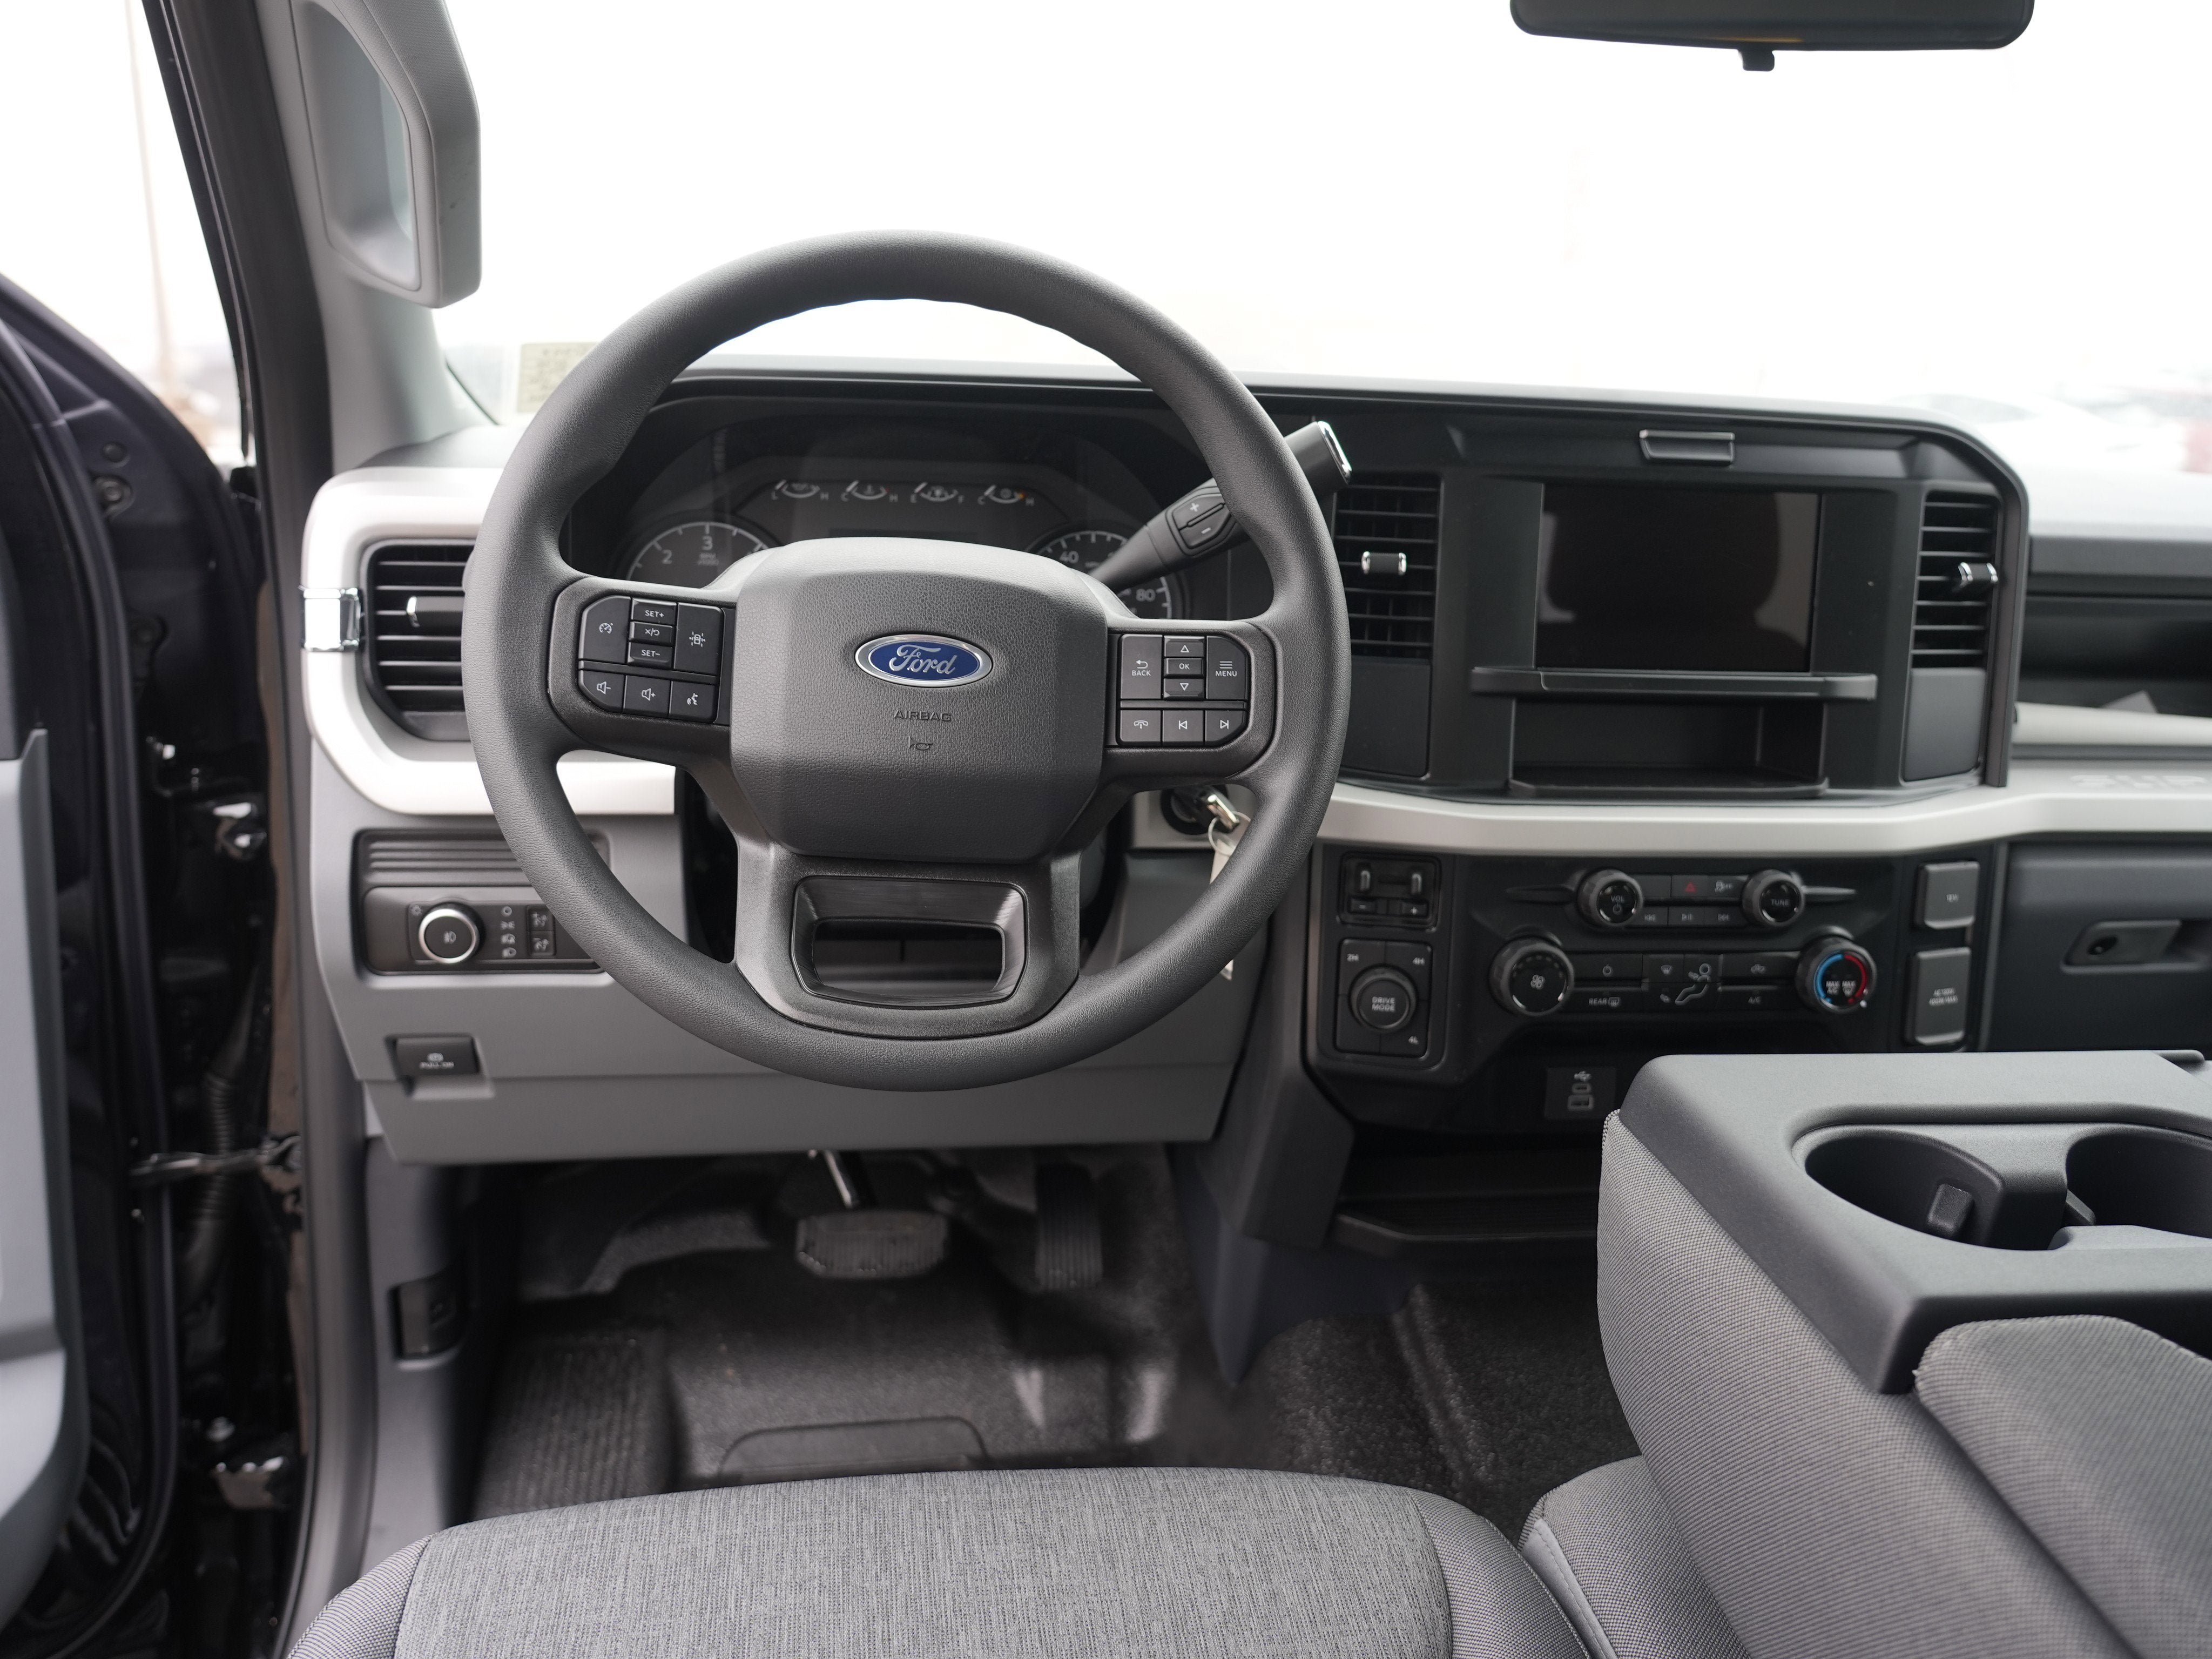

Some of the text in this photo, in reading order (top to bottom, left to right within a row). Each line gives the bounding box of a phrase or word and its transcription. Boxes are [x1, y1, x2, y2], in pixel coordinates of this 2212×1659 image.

[703, 536, 713, 550] 3
[662, 549, 672, 564] 2
[1060, 551, 1079, 564] 40
[1136, 589, 1156, 602] 80
[889, 644, 957, 675] Ford
[893, 710, 952, 722] AIRBAG
[1610, 895, 1624, 903] VOL
[1771, 899, 1790, 907] TUNE
[1347, 953, 1359, 962] 2H
[1412, 957, 1425, 966] 4H
[1372, 996, 1395, 1004] DRIVE
[1748, 996, 1762, 1004] A/C
[1372, 1004, 1396, 1013] MODE
[1408, 1036, 1419, 1044] 4L
